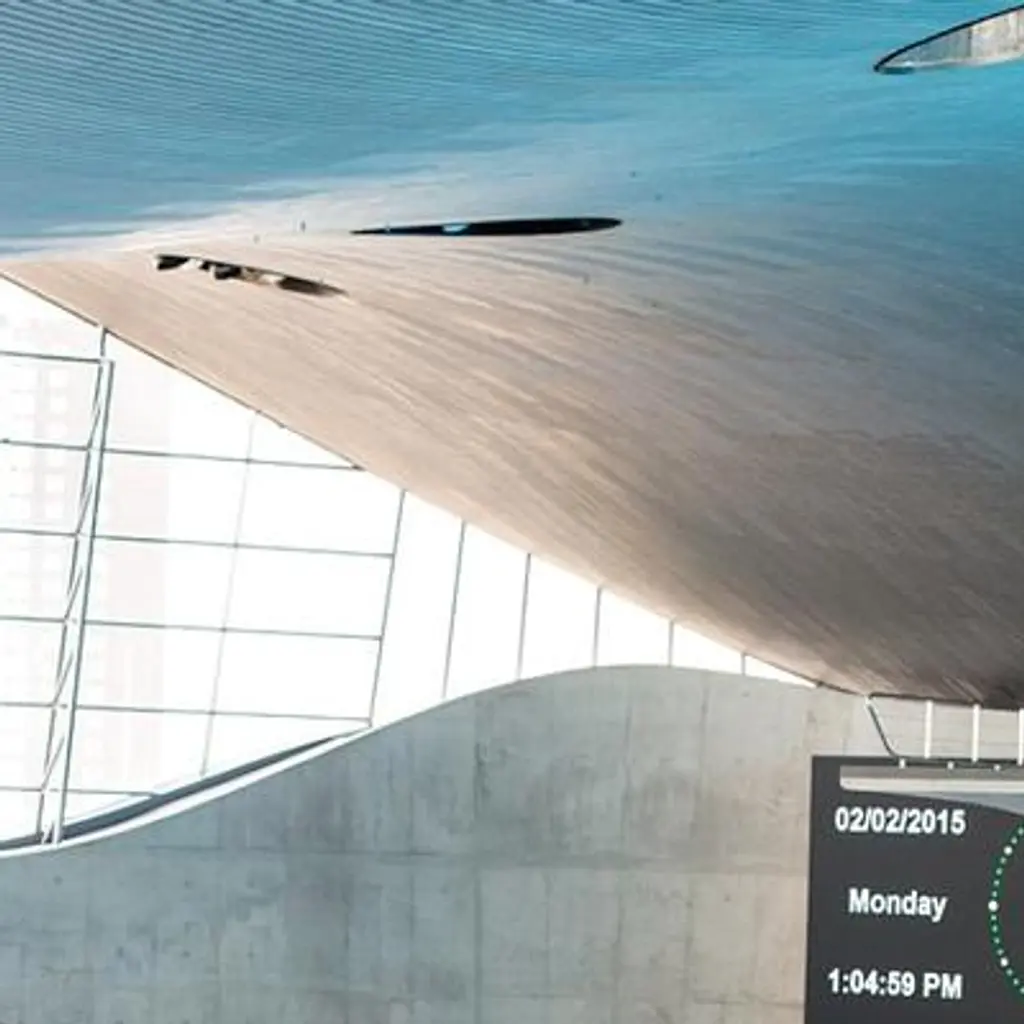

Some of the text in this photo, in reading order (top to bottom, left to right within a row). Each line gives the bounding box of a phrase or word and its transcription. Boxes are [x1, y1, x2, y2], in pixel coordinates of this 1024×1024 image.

[834, 806, 966, 834] 02/02/2015
[848, 887, 947, 923] Monday
[827, 968, 963, 999] 1:04:59 PM
